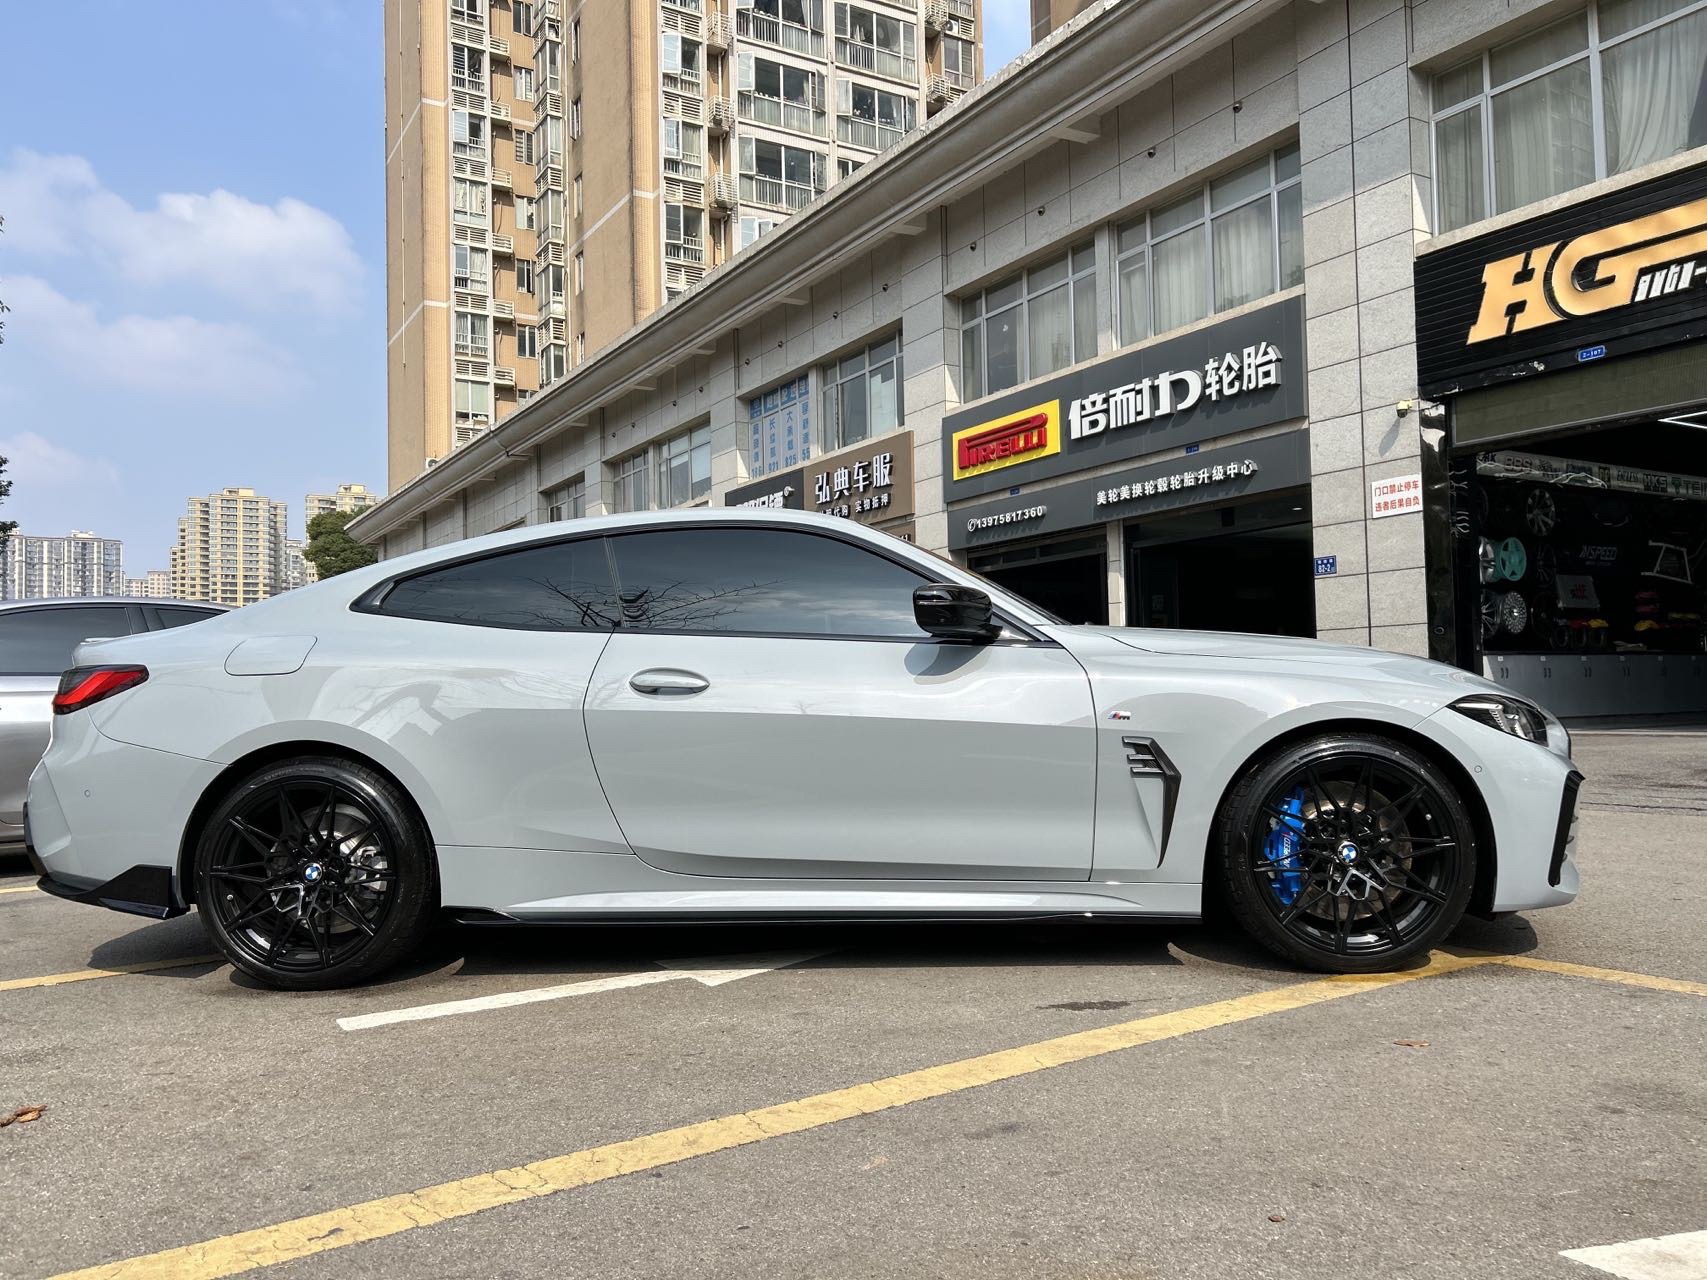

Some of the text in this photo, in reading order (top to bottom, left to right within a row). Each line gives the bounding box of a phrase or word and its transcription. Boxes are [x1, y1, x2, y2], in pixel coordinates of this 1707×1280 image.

[1069, 341, 1280, 440] 倍耐力轮胎
[958, 412, 1048, 470] PIRELLI
[815, 452, 891, 504] 弘典车服
[1374, 480, 1419, 497] 门口禁止停车
[977, 505, 1043, 528] 13975817360
[1375, 495, 1420, 512] 违者后果自负
